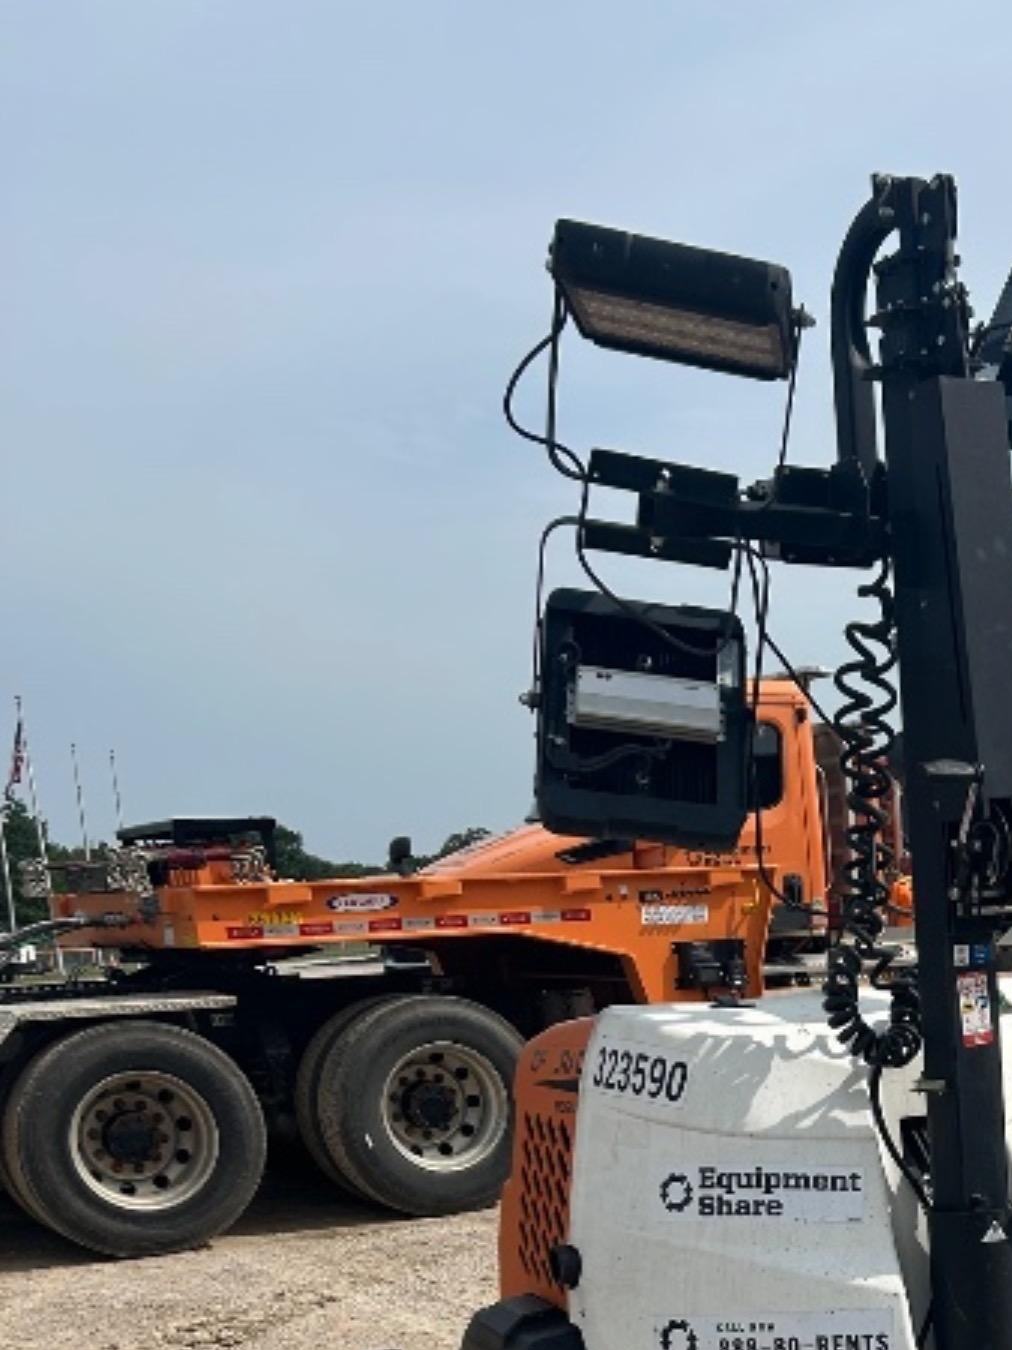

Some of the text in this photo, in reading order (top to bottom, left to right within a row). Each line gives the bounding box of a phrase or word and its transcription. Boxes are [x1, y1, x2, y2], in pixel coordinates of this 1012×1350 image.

[593, 1046, 688, 1102] 323590
[698, 1166, 862, 1195] Equipment
[698, 1195, 784, 1217] Share
